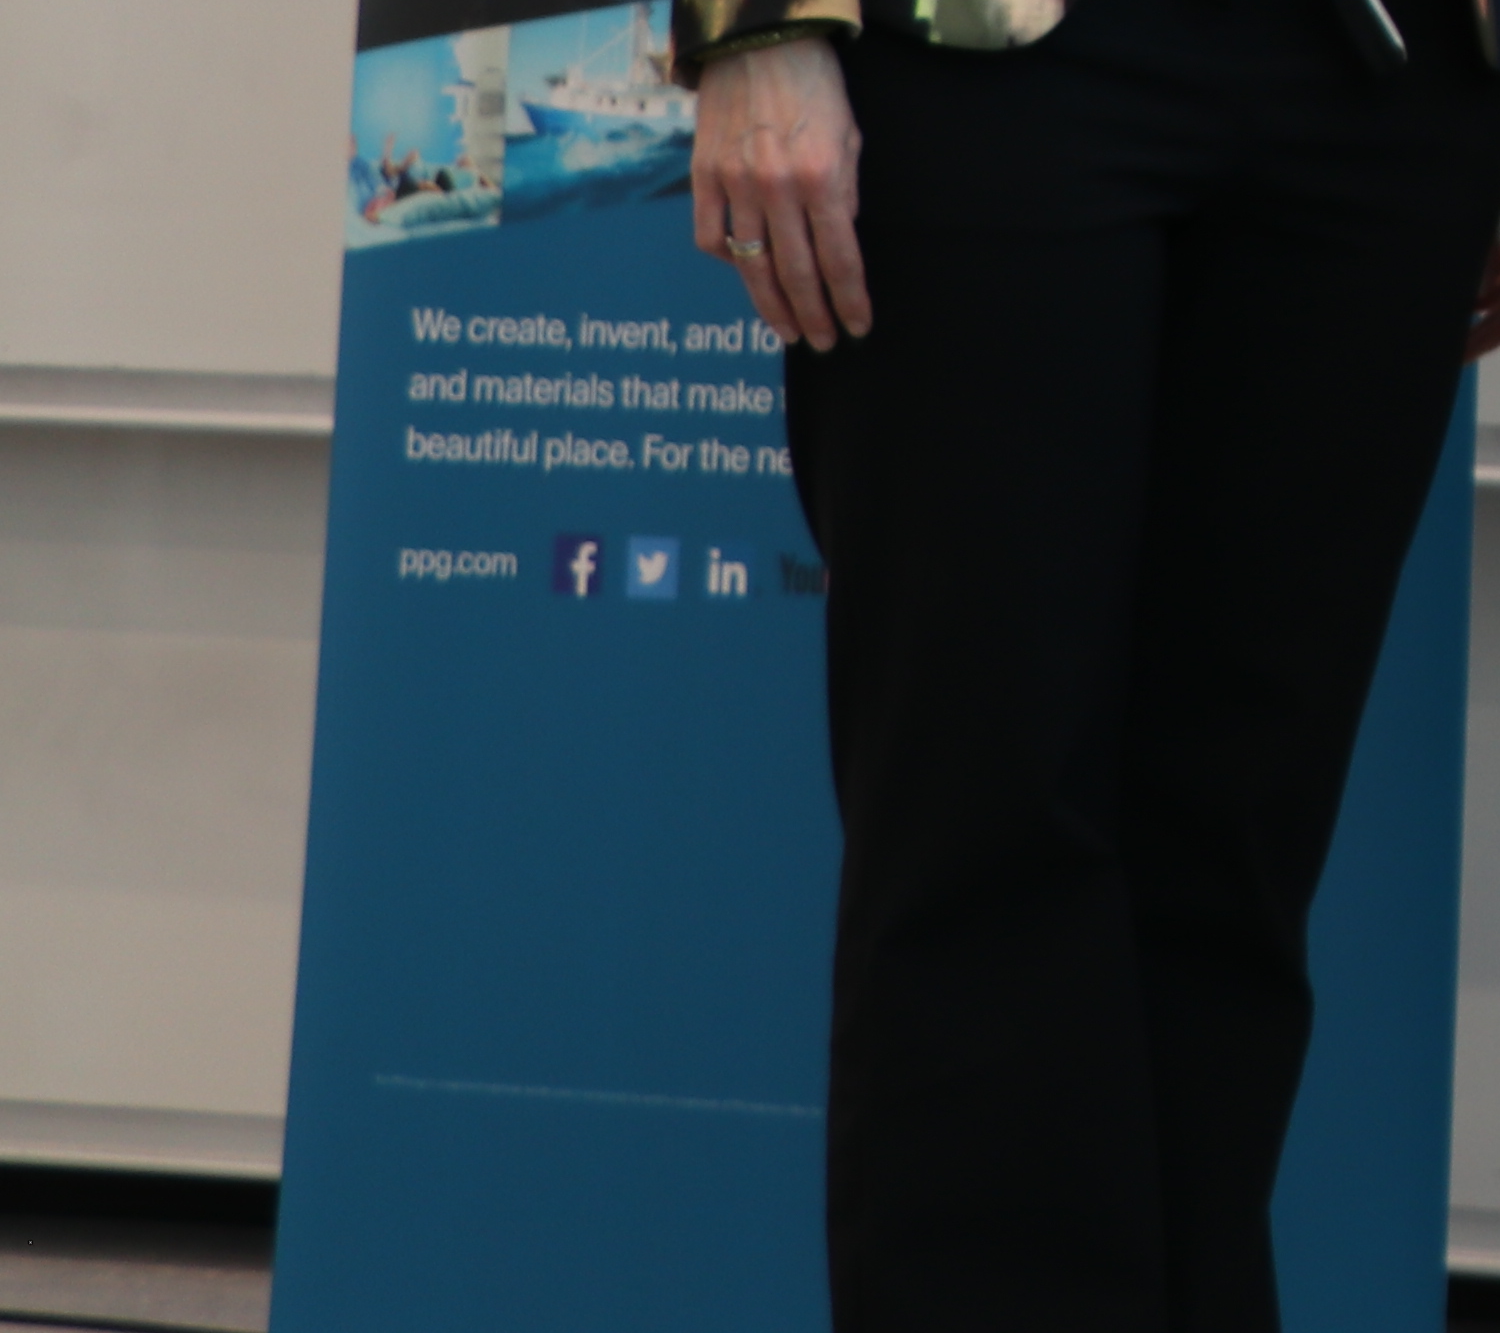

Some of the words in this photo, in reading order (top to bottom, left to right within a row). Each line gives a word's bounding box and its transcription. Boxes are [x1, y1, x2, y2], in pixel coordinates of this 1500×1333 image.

[413, 307, 460, 344] We
[467, 314, 572, 352] create,
[579, 313, 677, 356] invent,
[685, 319, 743, 353] and
[409, 369, 467, 402] and
[474, 373, 614, 410] materials
[621, 376, 681, 411] that
[688, 381, 774, 414] make
[406, 426, 537, 463] beautiful
[544, 432, 634, 473] place.
[643, 434, 693, 470] For
[699, 439, 749, 472] the
[400, 547, 518, 582] ppg.com
